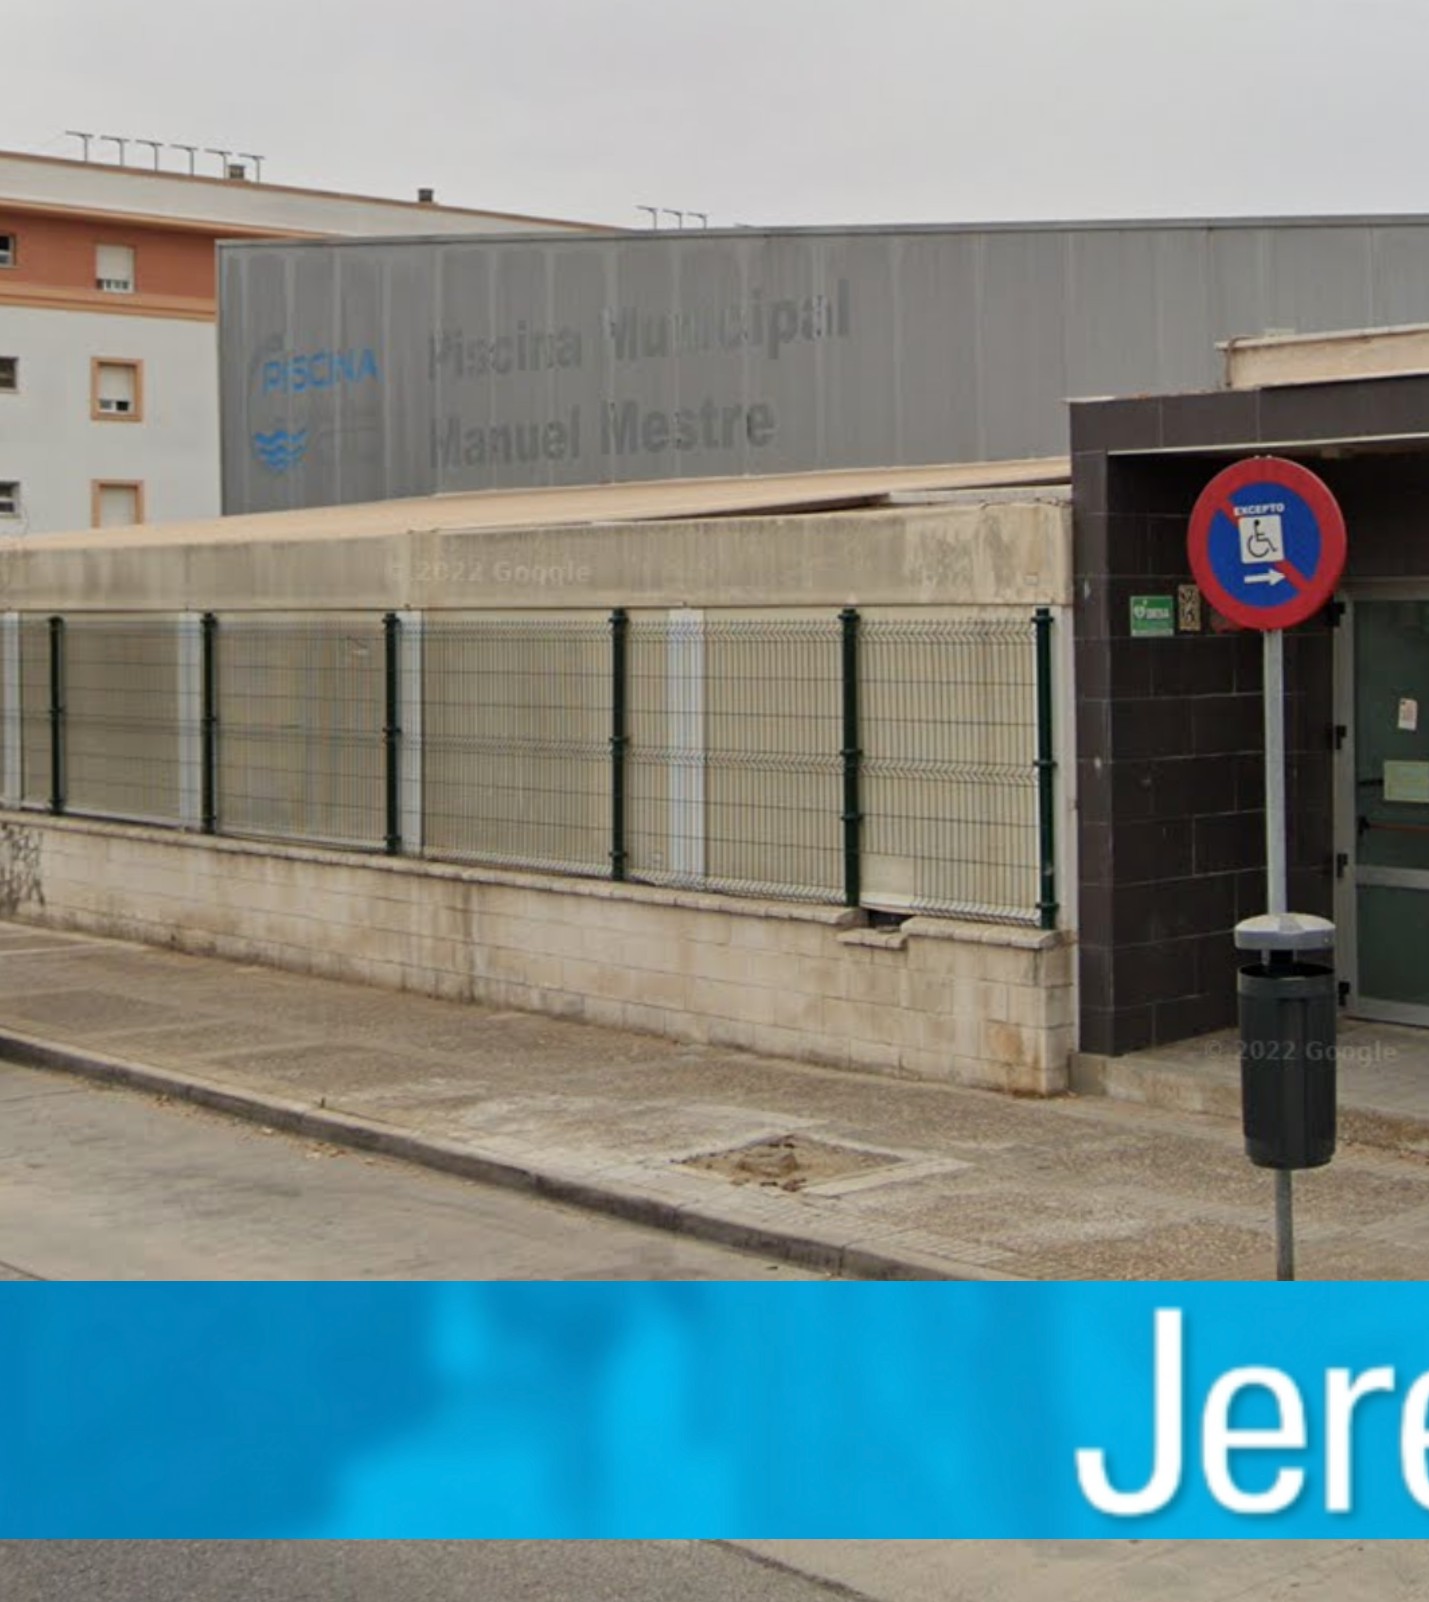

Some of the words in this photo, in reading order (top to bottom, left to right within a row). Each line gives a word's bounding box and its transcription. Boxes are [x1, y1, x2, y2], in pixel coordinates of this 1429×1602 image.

[427, 320, 583, 381] Piscina
[598, 279, 850, 361] Municipal
[262, 346, 379, 396] PISCINA
[428, 404, 581, 469] Manuel
[599, 396, 777, 457] Mestre
[1233, 502, 1285, 517] EXCEPTO
